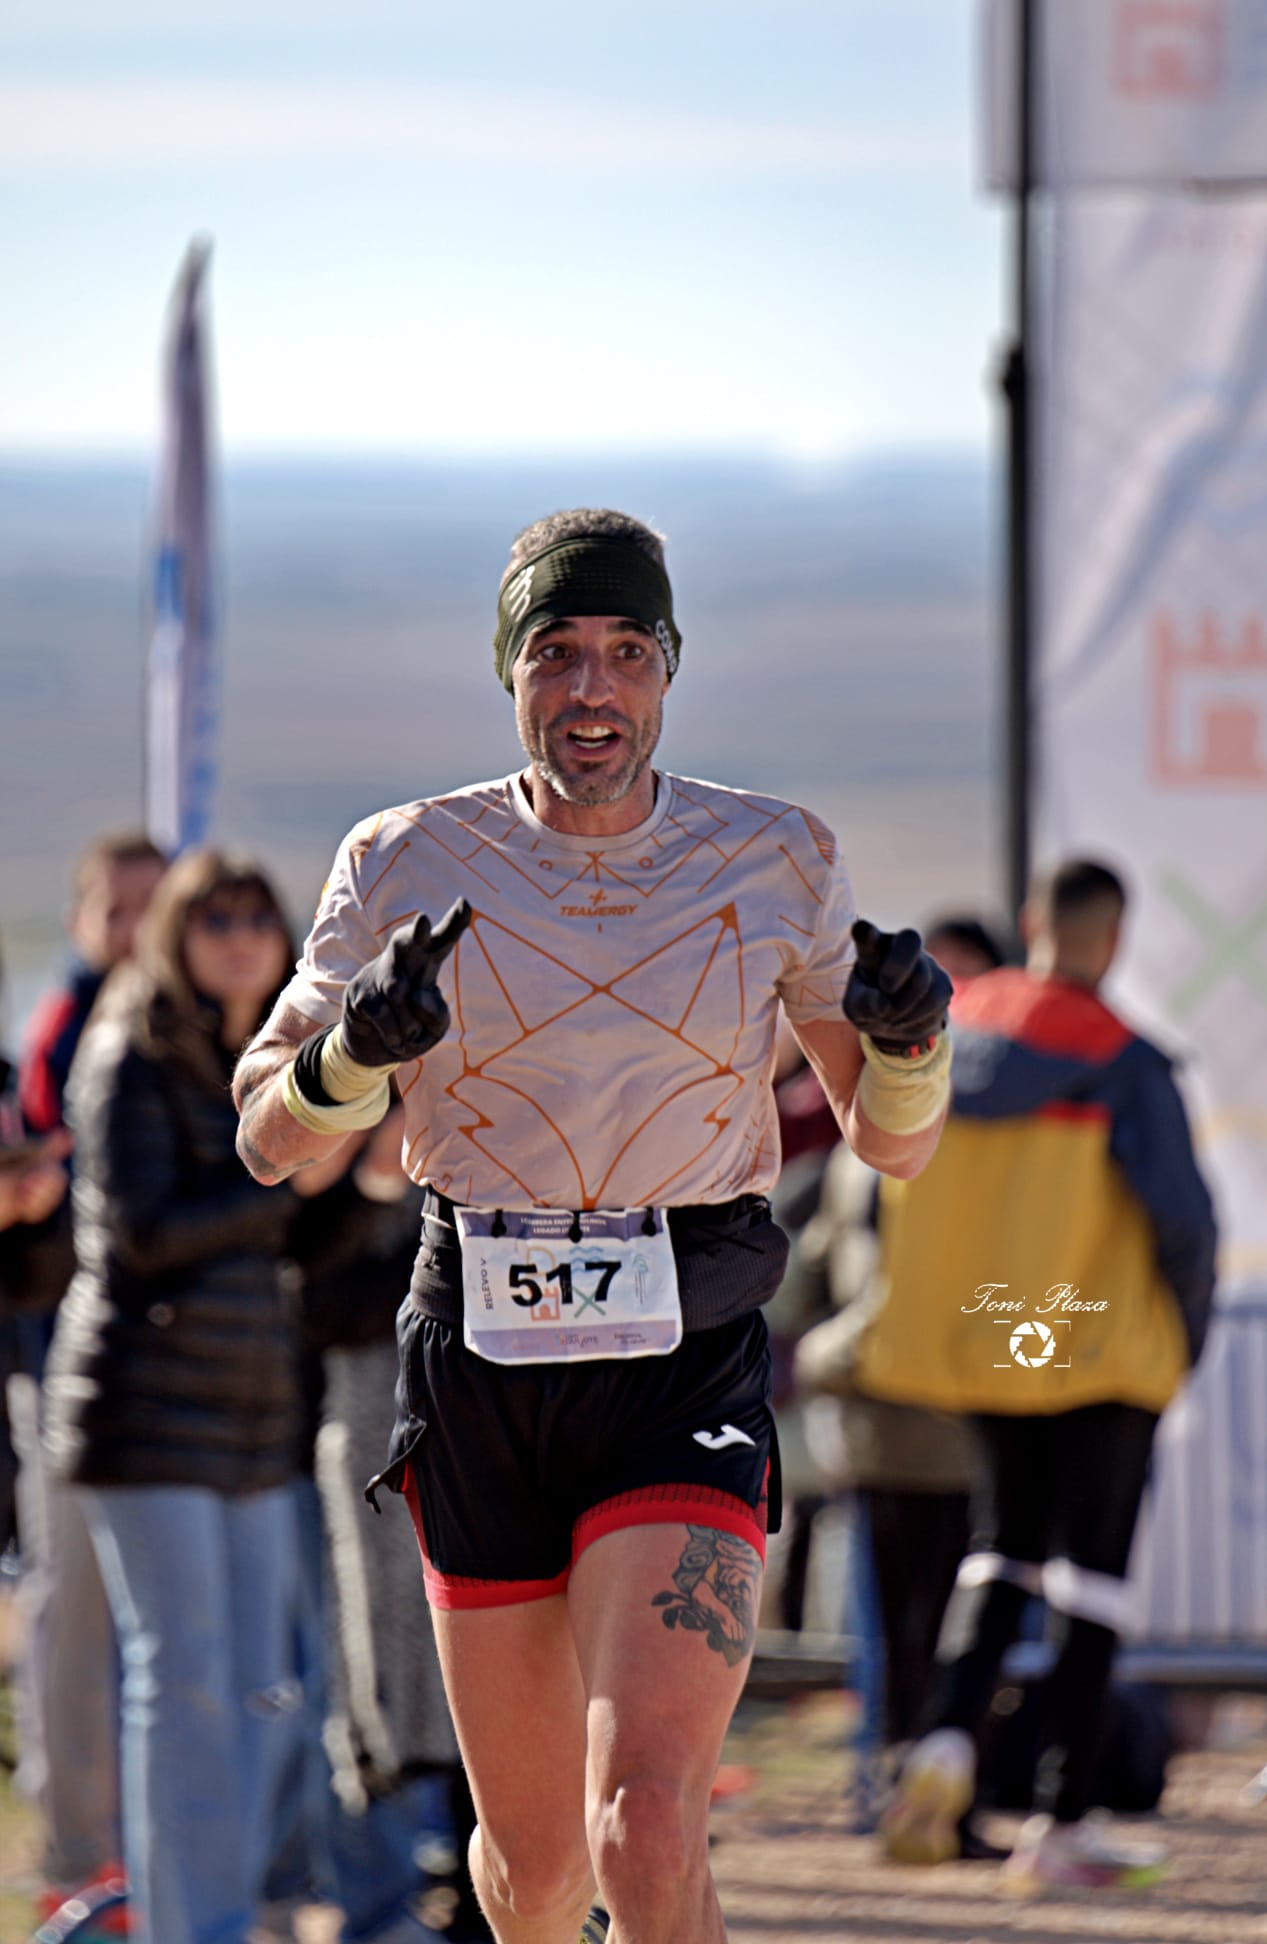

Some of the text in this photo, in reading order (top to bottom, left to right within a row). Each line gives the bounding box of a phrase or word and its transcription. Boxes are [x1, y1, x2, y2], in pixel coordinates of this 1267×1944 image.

[560, 905, 638, 917] TEAMERGY
[480, 1271, 494, 1310] RELEVO
[509, 1261, 622, 1307] 517
